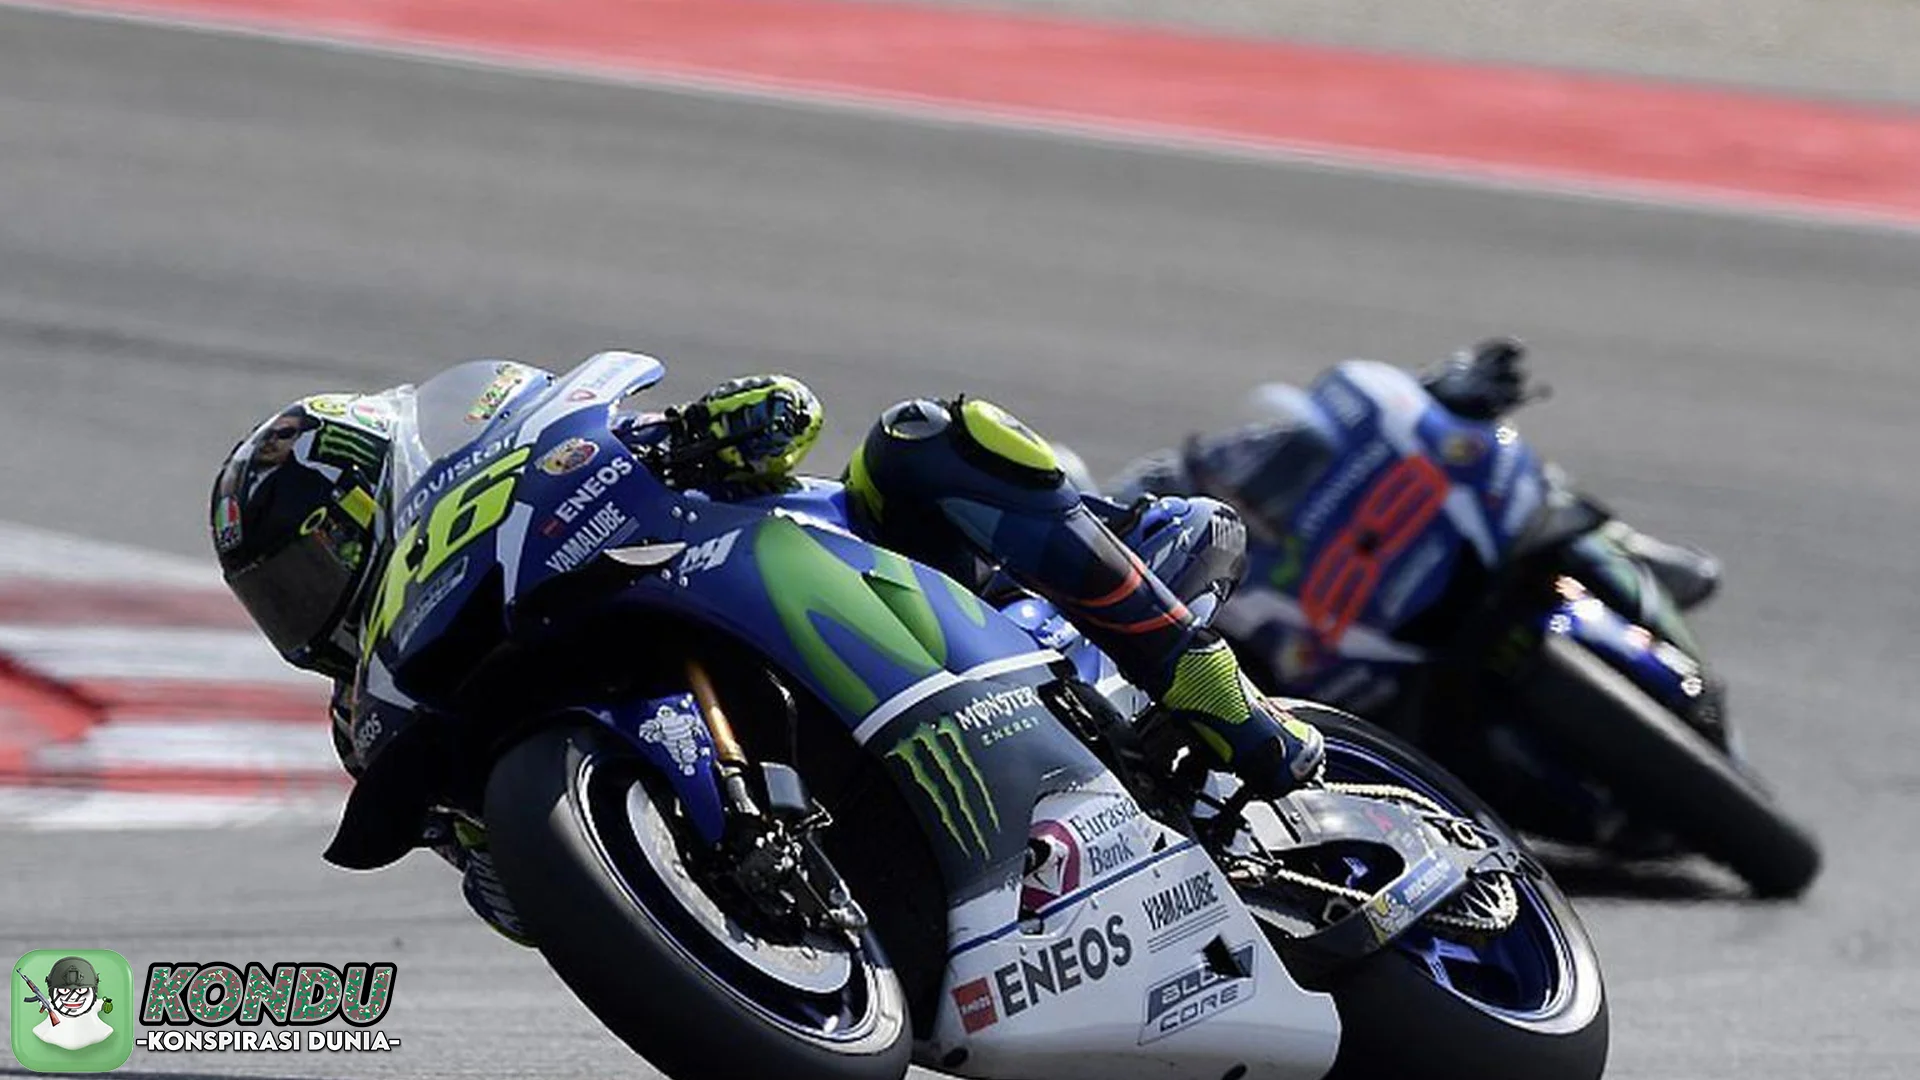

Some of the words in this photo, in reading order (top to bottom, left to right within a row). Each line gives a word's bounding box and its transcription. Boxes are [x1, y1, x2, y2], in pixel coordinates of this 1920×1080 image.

[555, 456, 633, 524] ENEOS
[363, 446, 530, 662] 46
[546, 501, 627, 573] YAMALUBE
[955, 685, 1043, 730] MONSTER
[980, 716, 1040, 746] ENERGY
[1087, 834, 1136, 875] Bank
[1141, 871, 1219, 931] YAMALUBE
[995, 915, 1133, 1018] ENEOS
[1161, 956, 1241, 1004] BLU
[1159, 985, 1240, 1032] CORE
